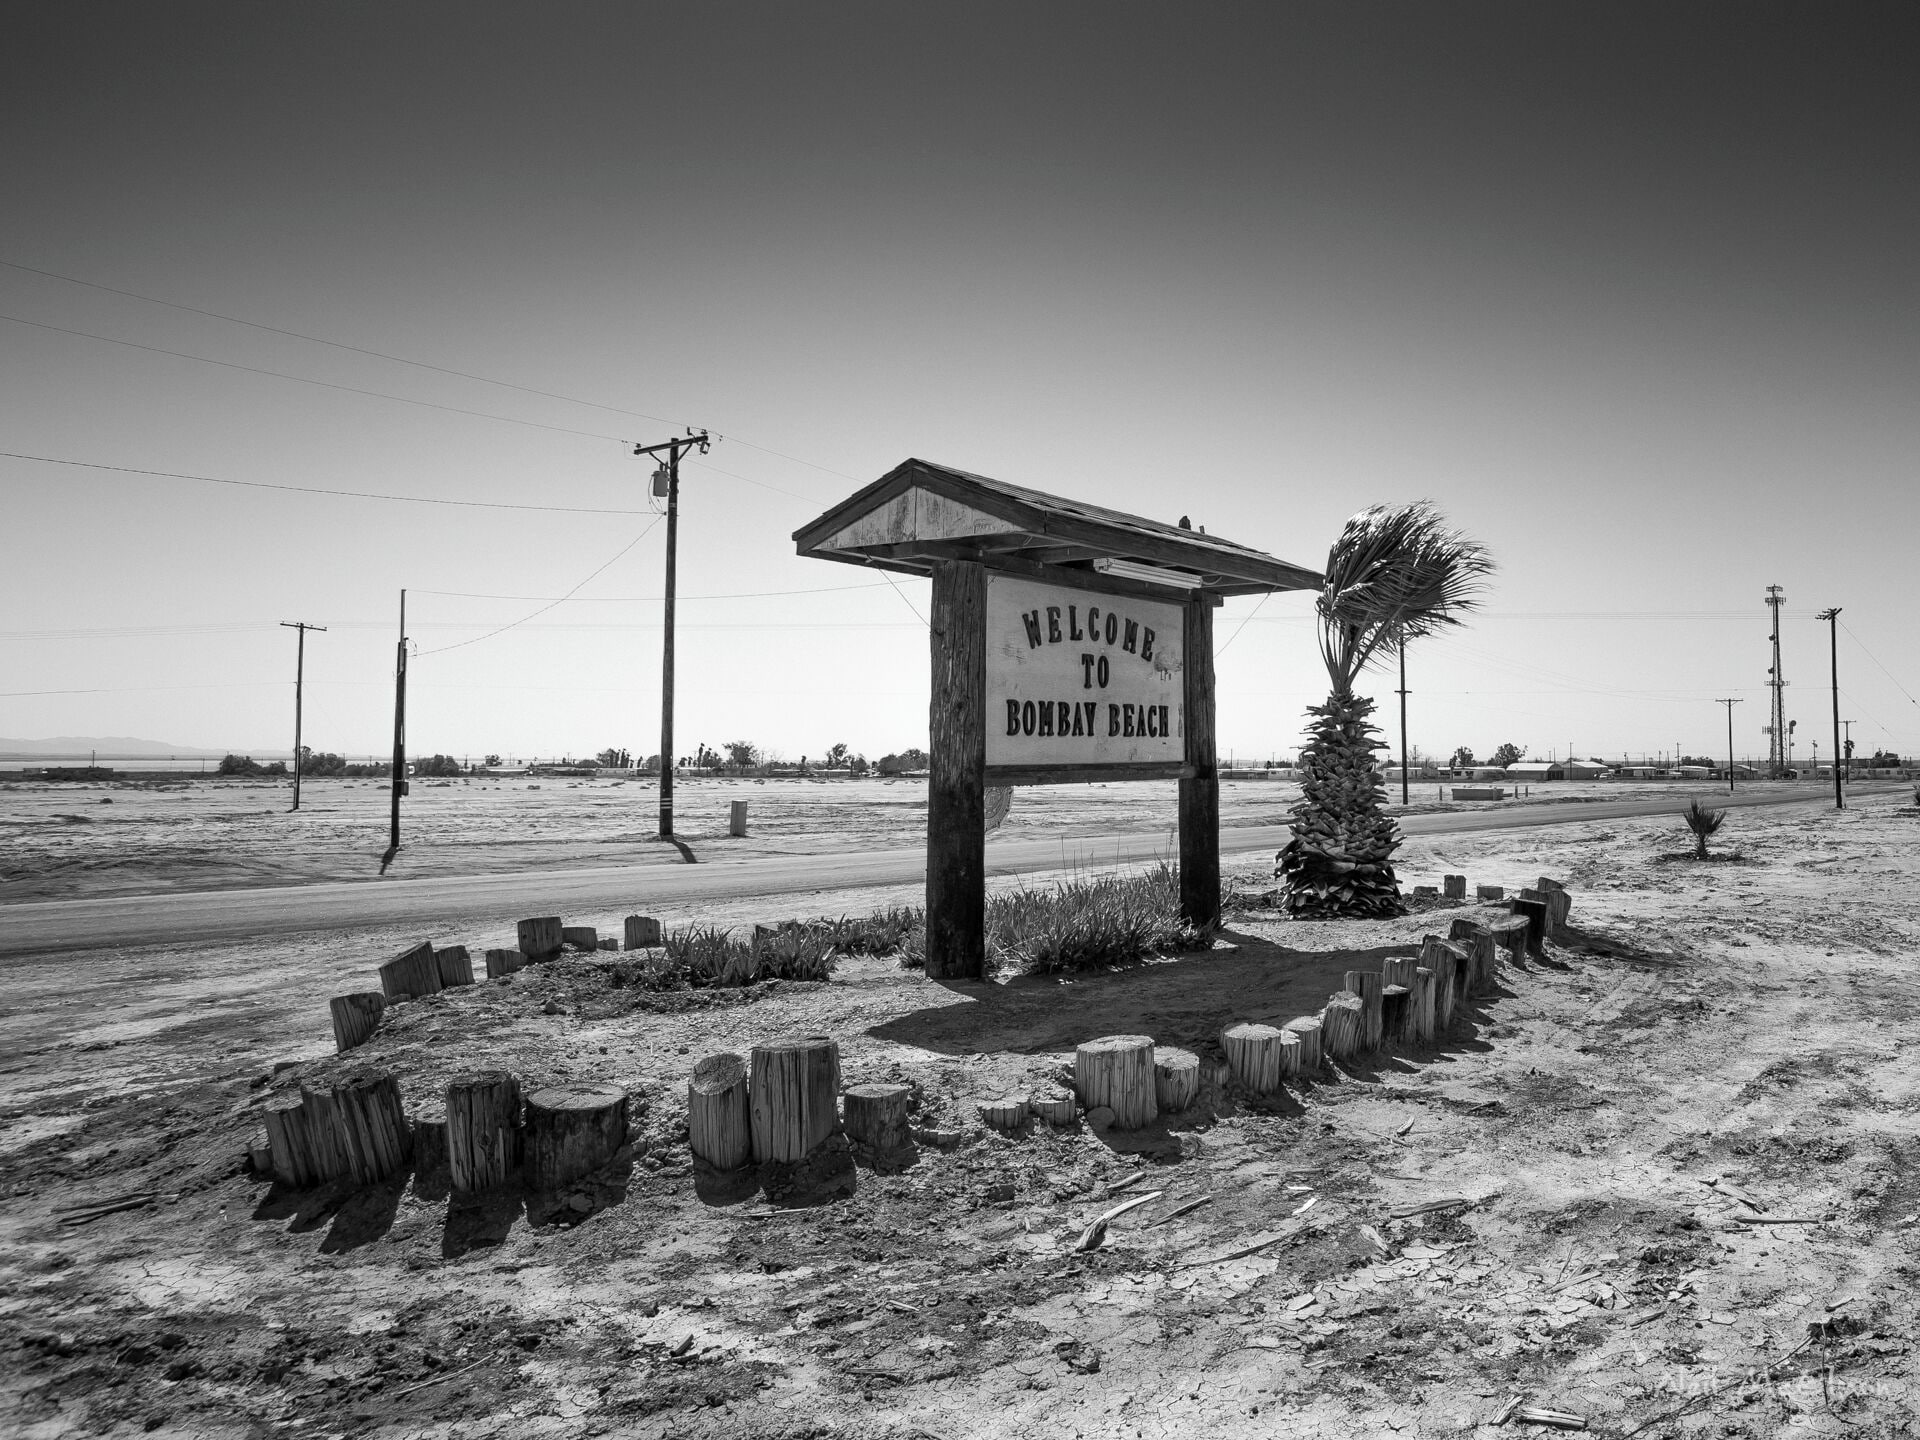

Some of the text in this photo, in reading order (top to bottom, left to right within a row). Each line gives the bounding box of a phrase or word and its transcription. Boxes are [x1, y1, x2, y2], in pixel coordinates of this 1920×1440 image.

[1022, 605, 1155, 662] WELCOME
[1081, 653, 1109, 689] TO
[1006, 699, 1096, 737] BOMBAY
[1108, 703, 1169, 738] BEACH
